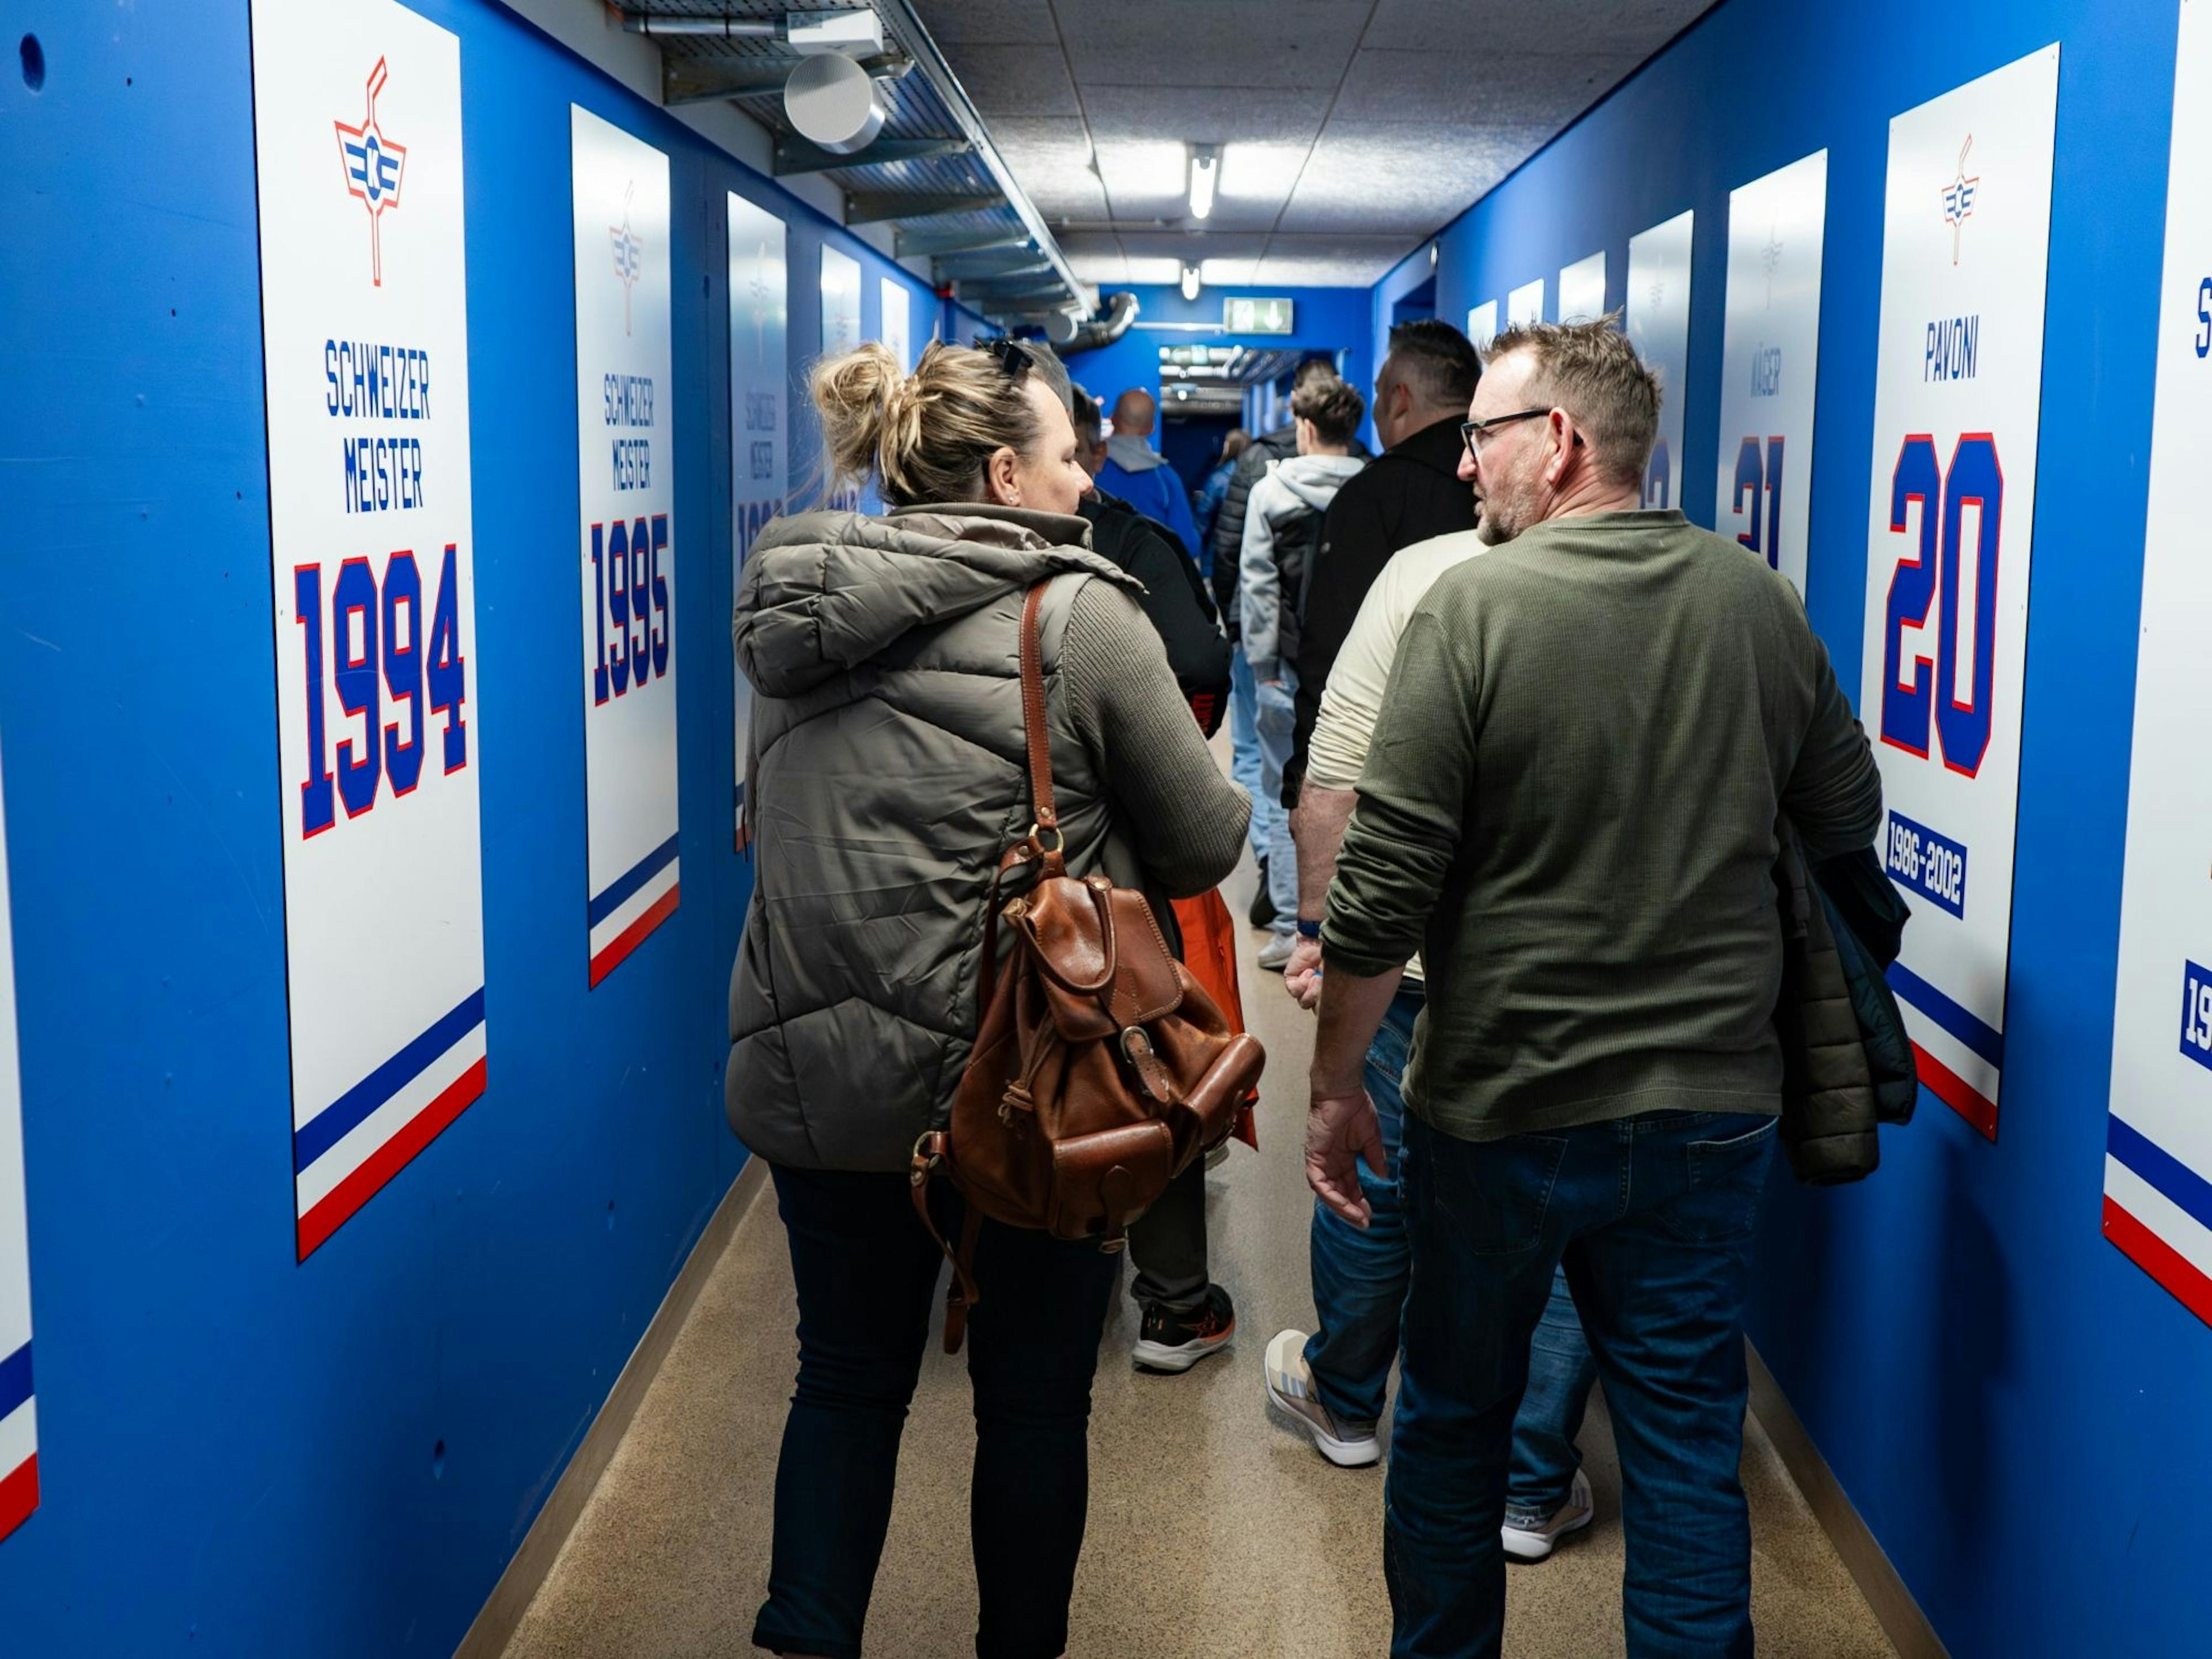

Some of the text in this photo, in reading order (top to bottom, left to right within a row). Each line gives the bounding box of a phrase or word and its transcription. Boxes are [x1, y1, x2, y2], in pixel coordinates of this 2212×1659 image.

[324, 339, 430, 420] SCHWEIZER
[1925, 315, 1979, 382] PAVONI
[604, 373, 654, 426] SCHWEIZER
[343, 438, 423, 514] MEISTER
[612, 439, 650, 491] MEISTER
[591, 514, 669, 707] 1995
[1880, 432, 2003, 779] 20
[294, 543, 468, 841] 1994
[1888, 821, 1963, 906] 1986-2002
